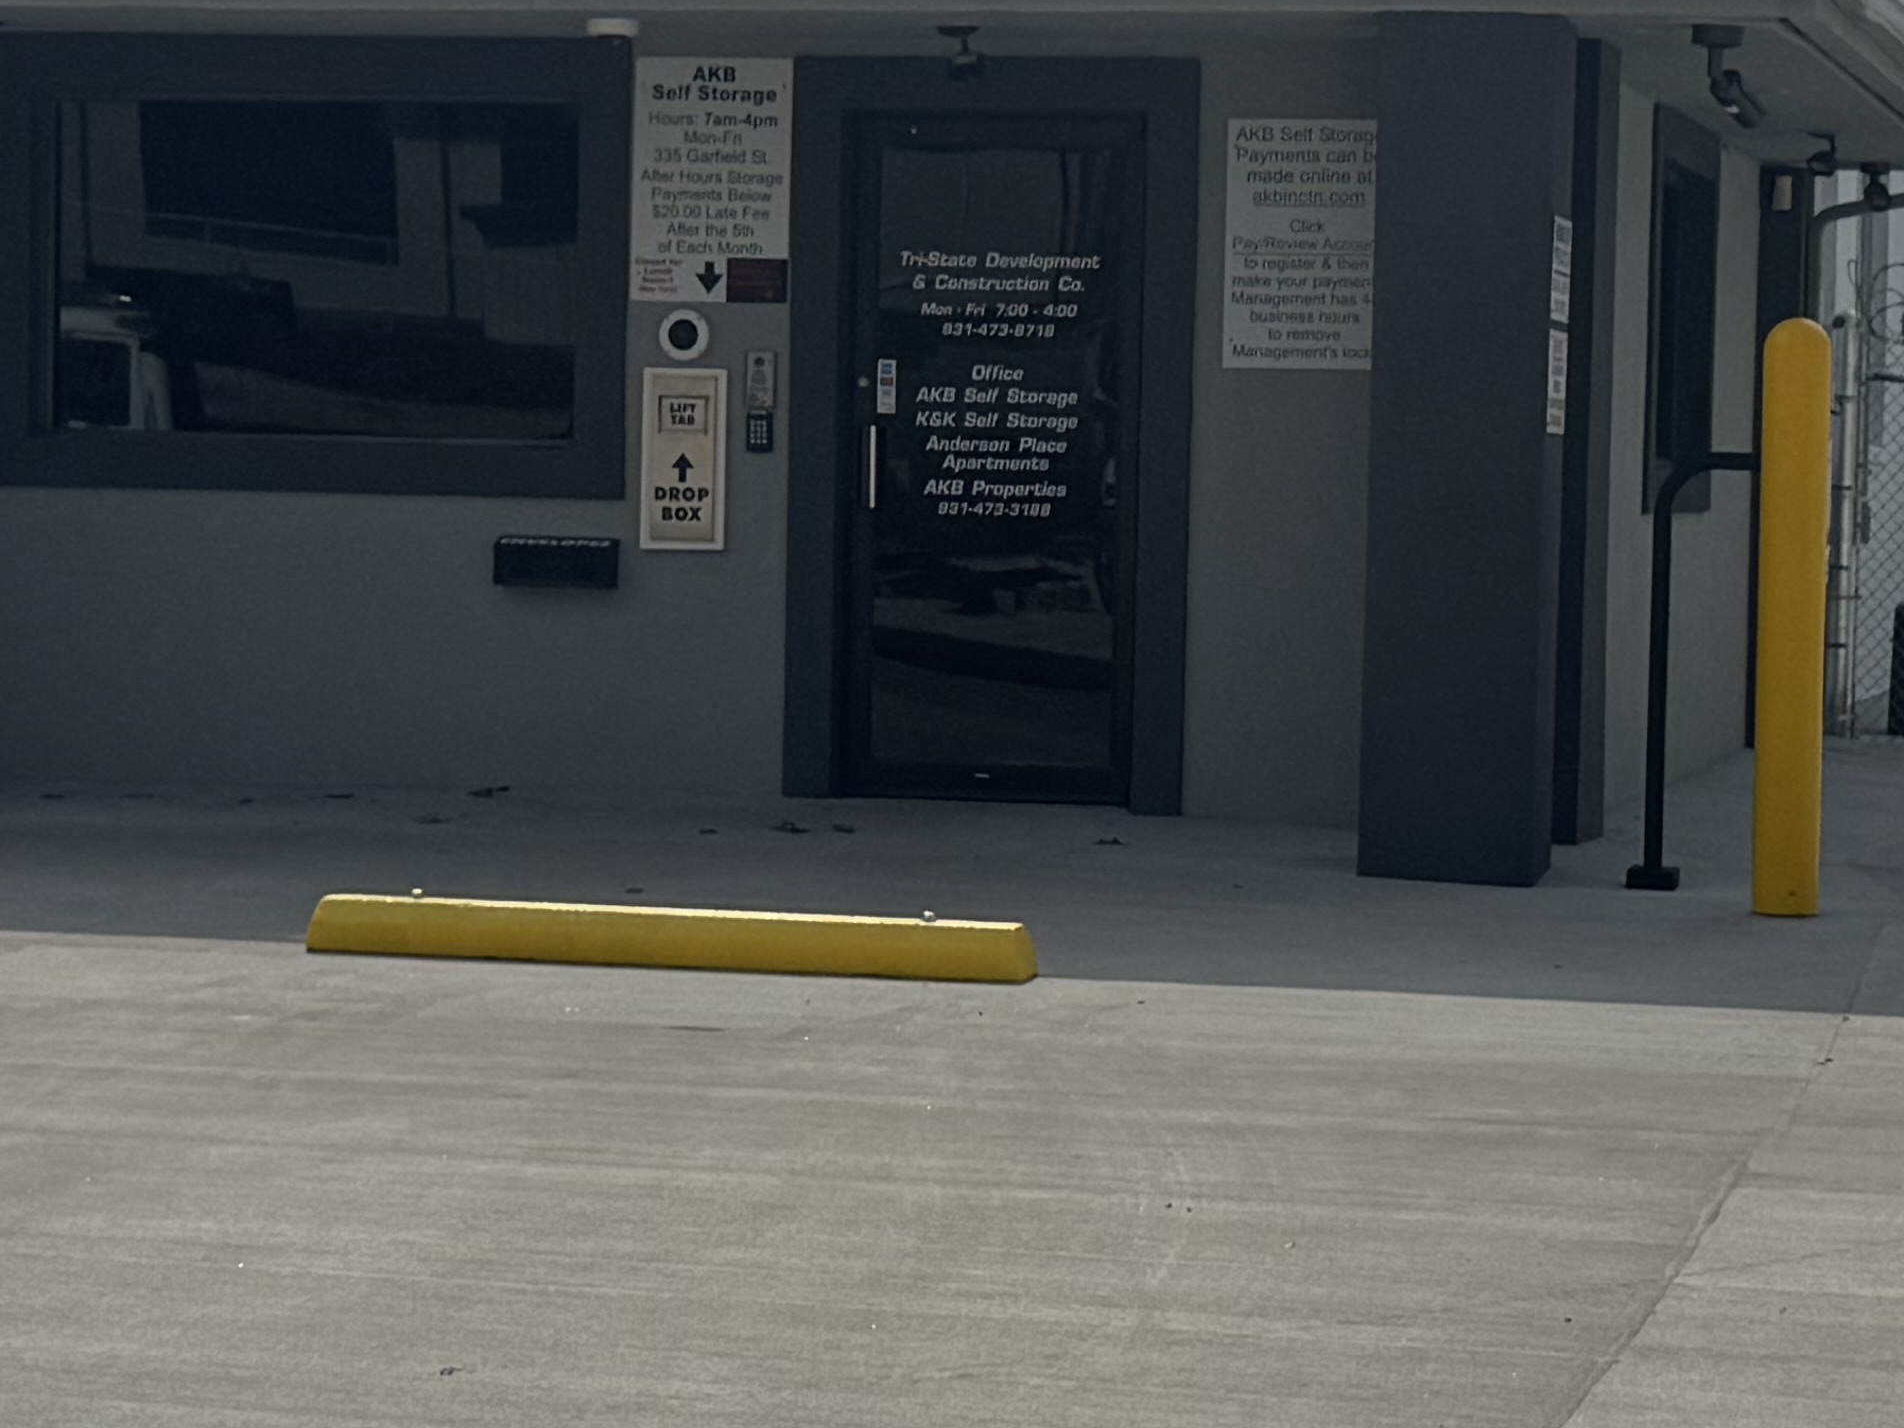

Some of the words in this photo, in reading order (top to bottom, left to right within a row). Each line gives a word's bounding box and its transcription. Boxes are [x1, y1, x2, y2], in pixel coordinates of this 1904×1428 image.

[693, 66, 736, 82] AKB
[653, 85, 691, 100] Self
[698, 86, 777, 105] Storage
[704, 112, 778, 129] 7am-4pm
[684, 131, 742, 144] Mon-Fri
[1236, 127, 1274, 142] AKB
[1281, 127, 1313, 142] Self
[1319, 127, 1377, 146] Storag
[654, 149, 682, 163] 335
[686, 149, 746, 164] Garfield
[1236, 148, 1320, 165] Payments
[1326, 151, 1357, 163] can
[1363, 149, 1377, 163] b
[641, 170, 675, 182] After
[679, 170, 722, 184] Hours
[727, 171, 783, 188] Storage
[1247, 171, 1294, 184] made
[1300, 171, 1351, 184] online
[1357, 172, 1373, 184] at
[651, 188, 723, 203] Payments
[728, 188, 772, 203] Below
[705, 206, 738, 219] Late
[742, 207, 769, 220] Fee
[667, 223, 700, 236] After
[705, 223, 727, 236] the
[732, 224, 754, 237] 5th
[1290, 220, 1325, 233] Click
[658, 241, 673, 253] of
[677, 241, 712, 254] Each
[717, 242, 762, 255] Month
[900, 251, 976, 268] Tri-State
[986, 252, 1100, 272] Development
[1244, 257, 1258, 270] to
[1262, 257, 1316, 273] register
[1337, 257, 1369, 270] then
[912, 275, 925, 290] &
[935, 274, 1050, 292] Construction
[1058, 276, 1085, 292] Co.
[1232, 275, 1271, 287] make
[1277, 277, 1307, 290] your
[1313, 277, 1373, 291] paymen
[1232, 292, 1326, 307] Management
[1331, 292, 1357, 305] has
[920, 302, 952, 316] Mon
[965, 303, 985, 316] Fri
[996, 304, 1028, 317] 7:00
[1043, 304, 1078, 317] 4:00
[1250, 309, 1314, 322] business
[1318, 310, 1360, 323] hours
[1268, 327, 1282, 340] to
[1286, 329, 1341, 341] remove
[1233, 344, 1338, 360] Management's
[972, 364, 1024, 381] Office
[916, 387, 956, 403] AKB
[964, 388, 998, 404] Self
[1006, 388, 1078, 408] Storage
[670, 403, 696, 413] LIFT
[670, 414, 695, 426] TAB
[916, 412, 956, 428] K&K
[964, 412, 999, 428] Self
[1006, 413, 1078, 432] Storage
[926, 435, 1010, 452] Anderson
[1018, 438, 1067, 452] Place
[942, 454, 1050, 472] Apartments
[654, 486, 709, 502] DROP
[924, 480, 964, 495] AKB
[972, 480, 1067, 499] Properties
[661, 507, 702, 521] BOX
